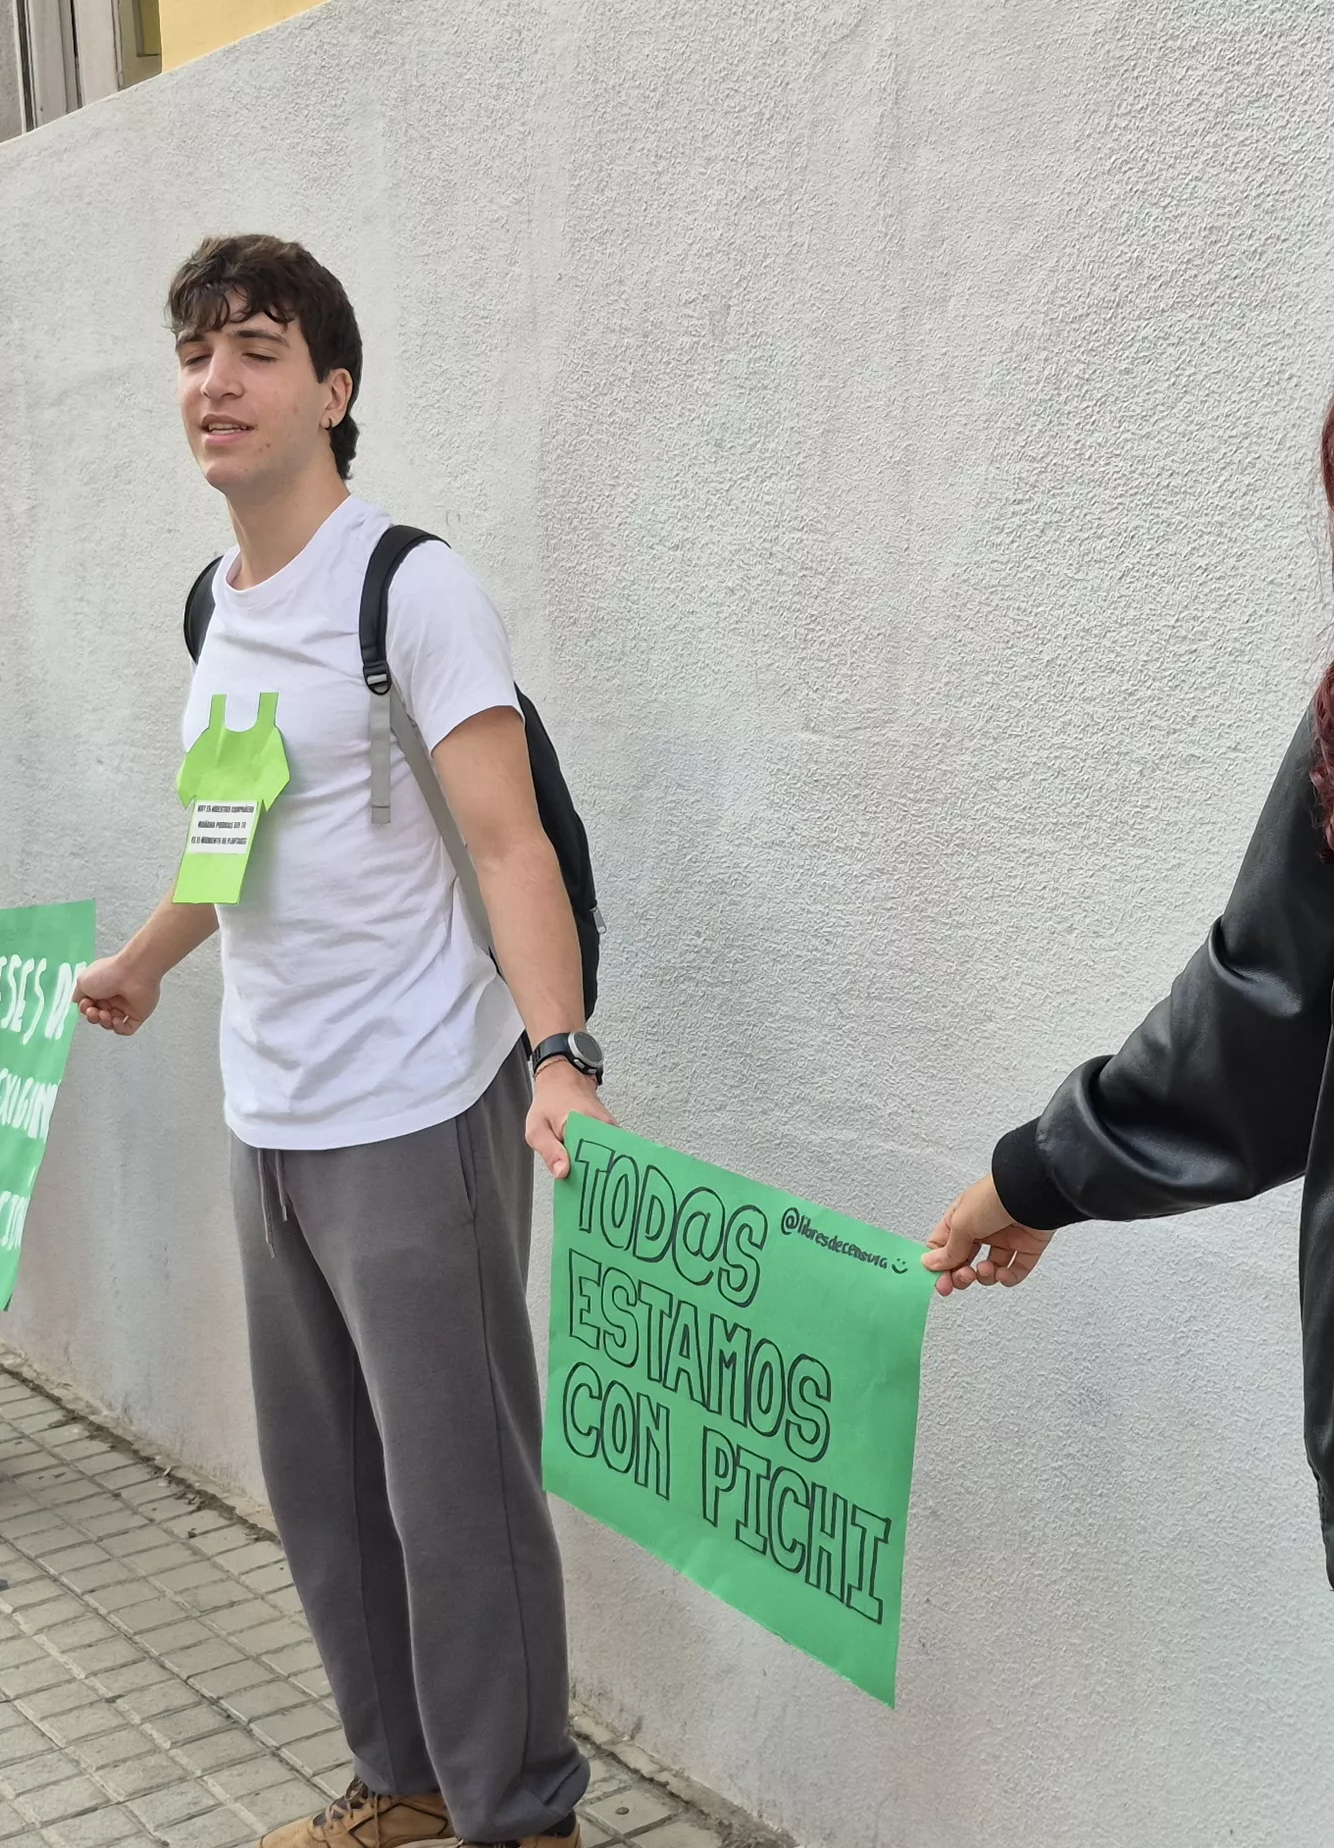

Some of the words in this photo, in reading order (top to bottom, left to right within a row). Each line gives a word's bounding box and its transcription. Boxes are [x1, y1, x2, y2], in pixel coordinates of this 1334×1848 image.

[574, 1139, 768, 1308] TOD@S
[781, 1207, 888, 1269] @libresdecensura
[569, 1248, 832, 1463] ESTAMOS
[564, 1361, 670, 1500] CON
[702, 1425, 892, 1625] PICHI
